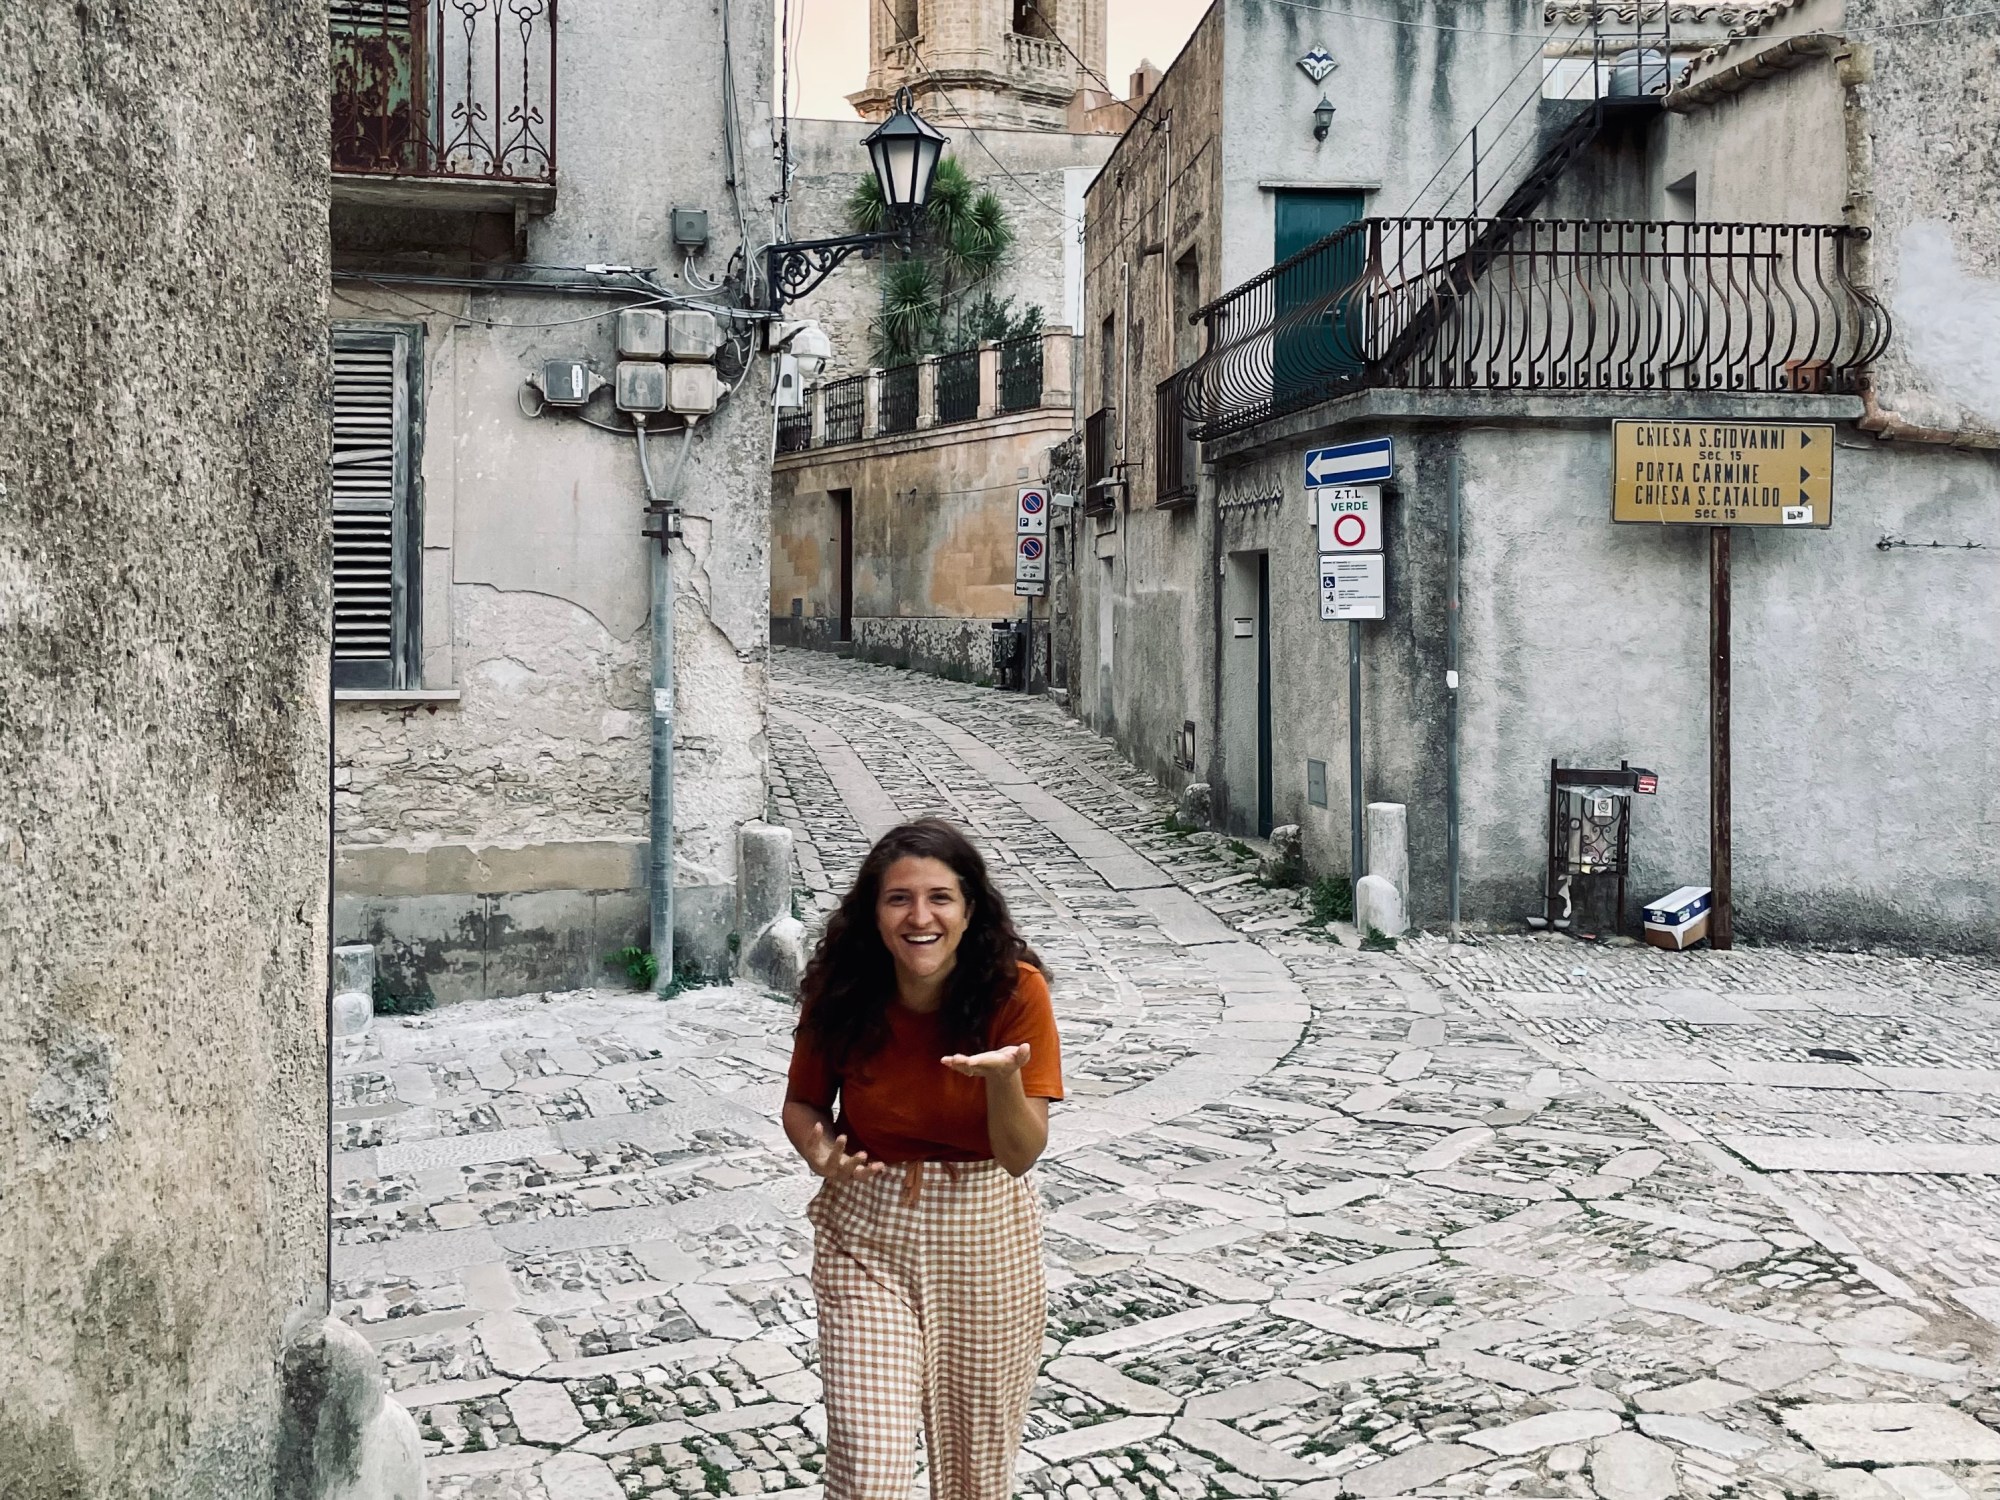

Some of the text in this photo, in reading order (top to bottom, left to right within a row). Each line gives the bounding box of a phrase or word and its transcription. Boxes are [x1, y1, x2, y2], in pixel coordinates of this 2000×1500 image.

[1637, 426, 1785, 450] CHIESA S.GIOVANNI
[1636, 462, 1760, 484] PORTA CARMINE
[1331, 501, 1369, 512] VERDE
[1635, 485, 1780, 507] CHIESA S.CATALDO
